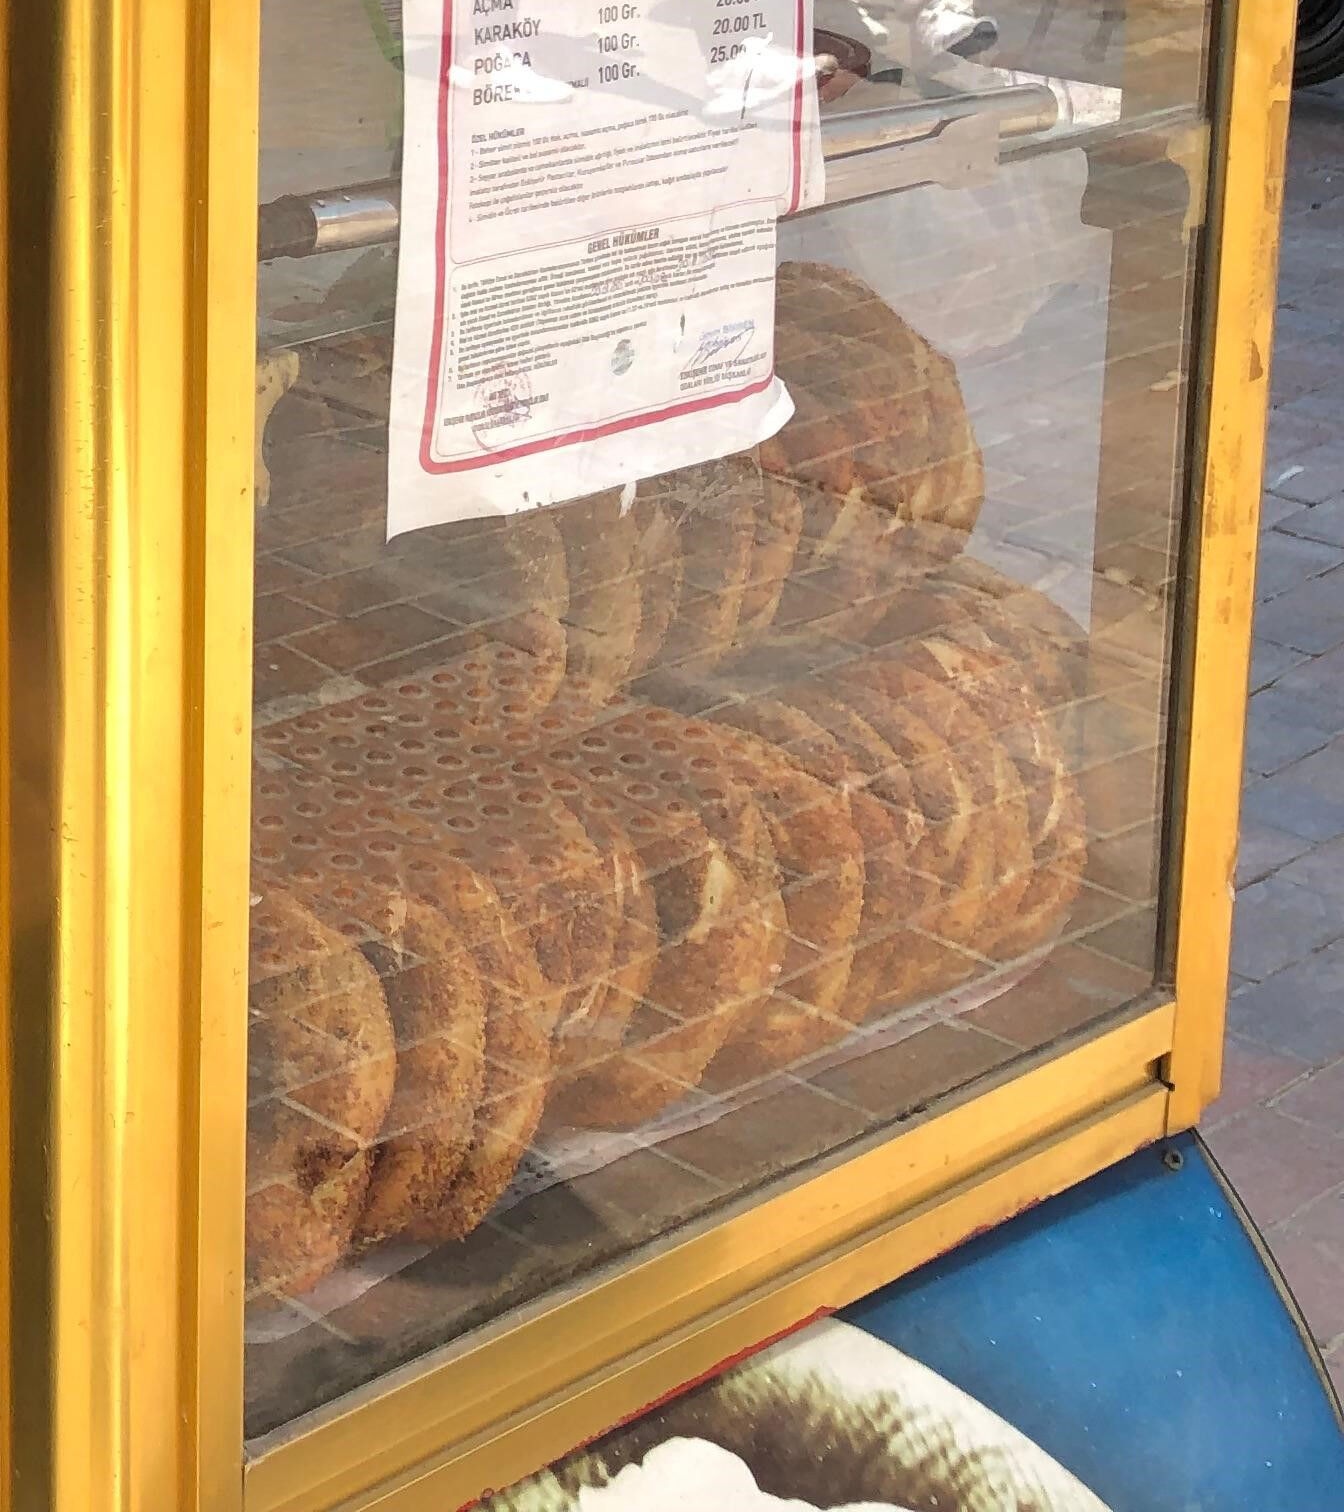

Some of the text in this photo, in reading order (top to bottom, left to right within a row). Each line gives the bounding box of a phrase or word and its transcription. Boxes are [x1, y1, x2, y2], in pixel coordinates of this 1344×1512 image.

[474, 18, 541, 46] KARAKÖY
[598, 5, 618, 24] 100
[621, 4, 641, 20] Gr.
[598, 35, 618, 54] 100
[621, 33, 640, 49] Gr.
[713, 15, 749, 36] 20.00
[753, 13, 767, 29] TL
[473, 83, 521, 106] BÖRE
[598, 64, 619, 84] 100
[622, 62, 640, 79] Gr.
